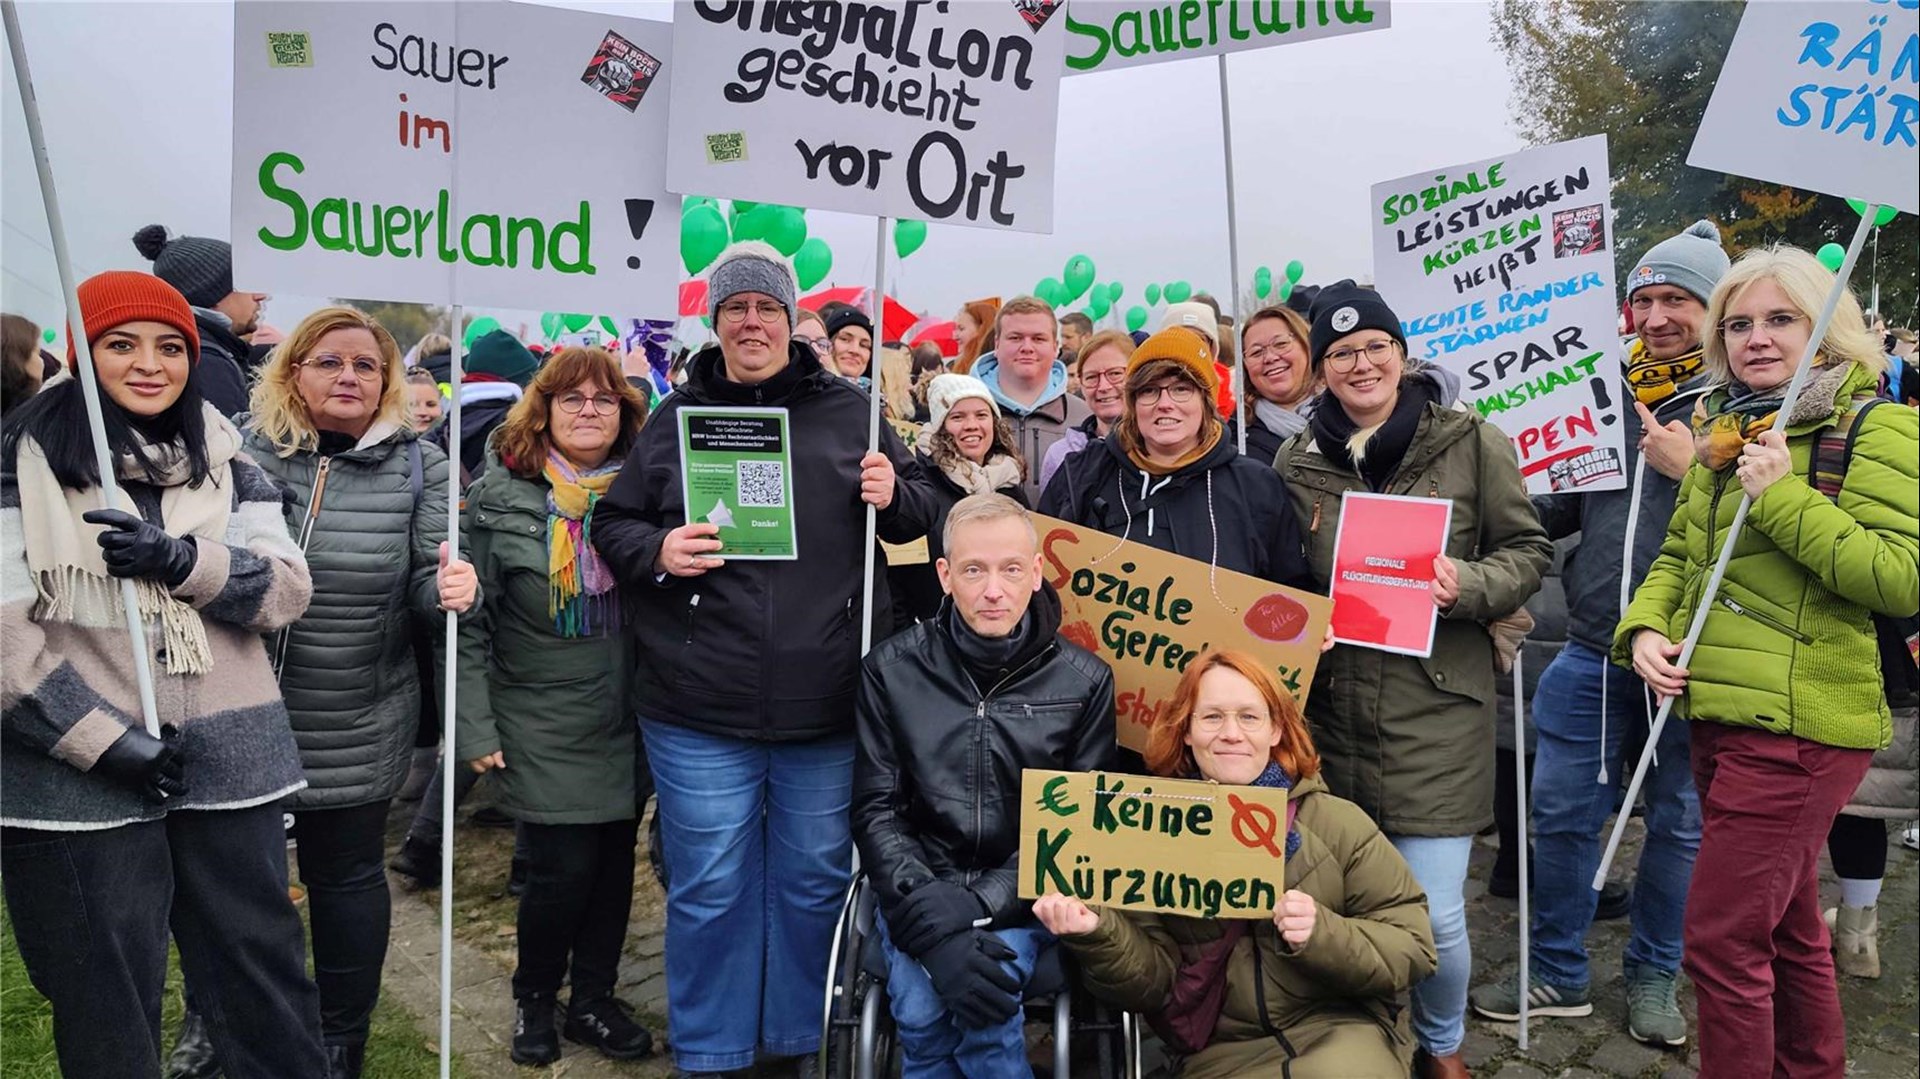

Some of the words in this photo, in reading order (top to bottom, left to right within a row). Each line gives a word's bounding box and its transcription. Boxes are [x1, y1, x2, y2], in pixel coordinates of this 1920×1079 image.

[371, 22, 509, 90] Sauer
[607, 36, 629, 53] KEIN
[624, 53, 653, 78] NAZIS
[724, 47, 980, 130] geschieht
[399, 93, 451, 153] im
[795, 138, 893, 190] vor
[906, 130, 1025, 226] Ort
[258, 151, 597, 275] Sauerland
[1423, 214, 1542, 276] KÜRZEN
[1498, 271, 1605, 313] RÄNDER
[1424, 308, 1549, 359] STÄRKEN
[1468, 326, 1589, 391] SPAR
[751, 519, 779, 528] Danke!
[1043, 528, 1193, 626] Soziale
[1364, 556, 1407, 571] REGIONALE
[1092, 774, 1214, 837] Keine
[1035, 827, 1276, 918] Kürzungen
